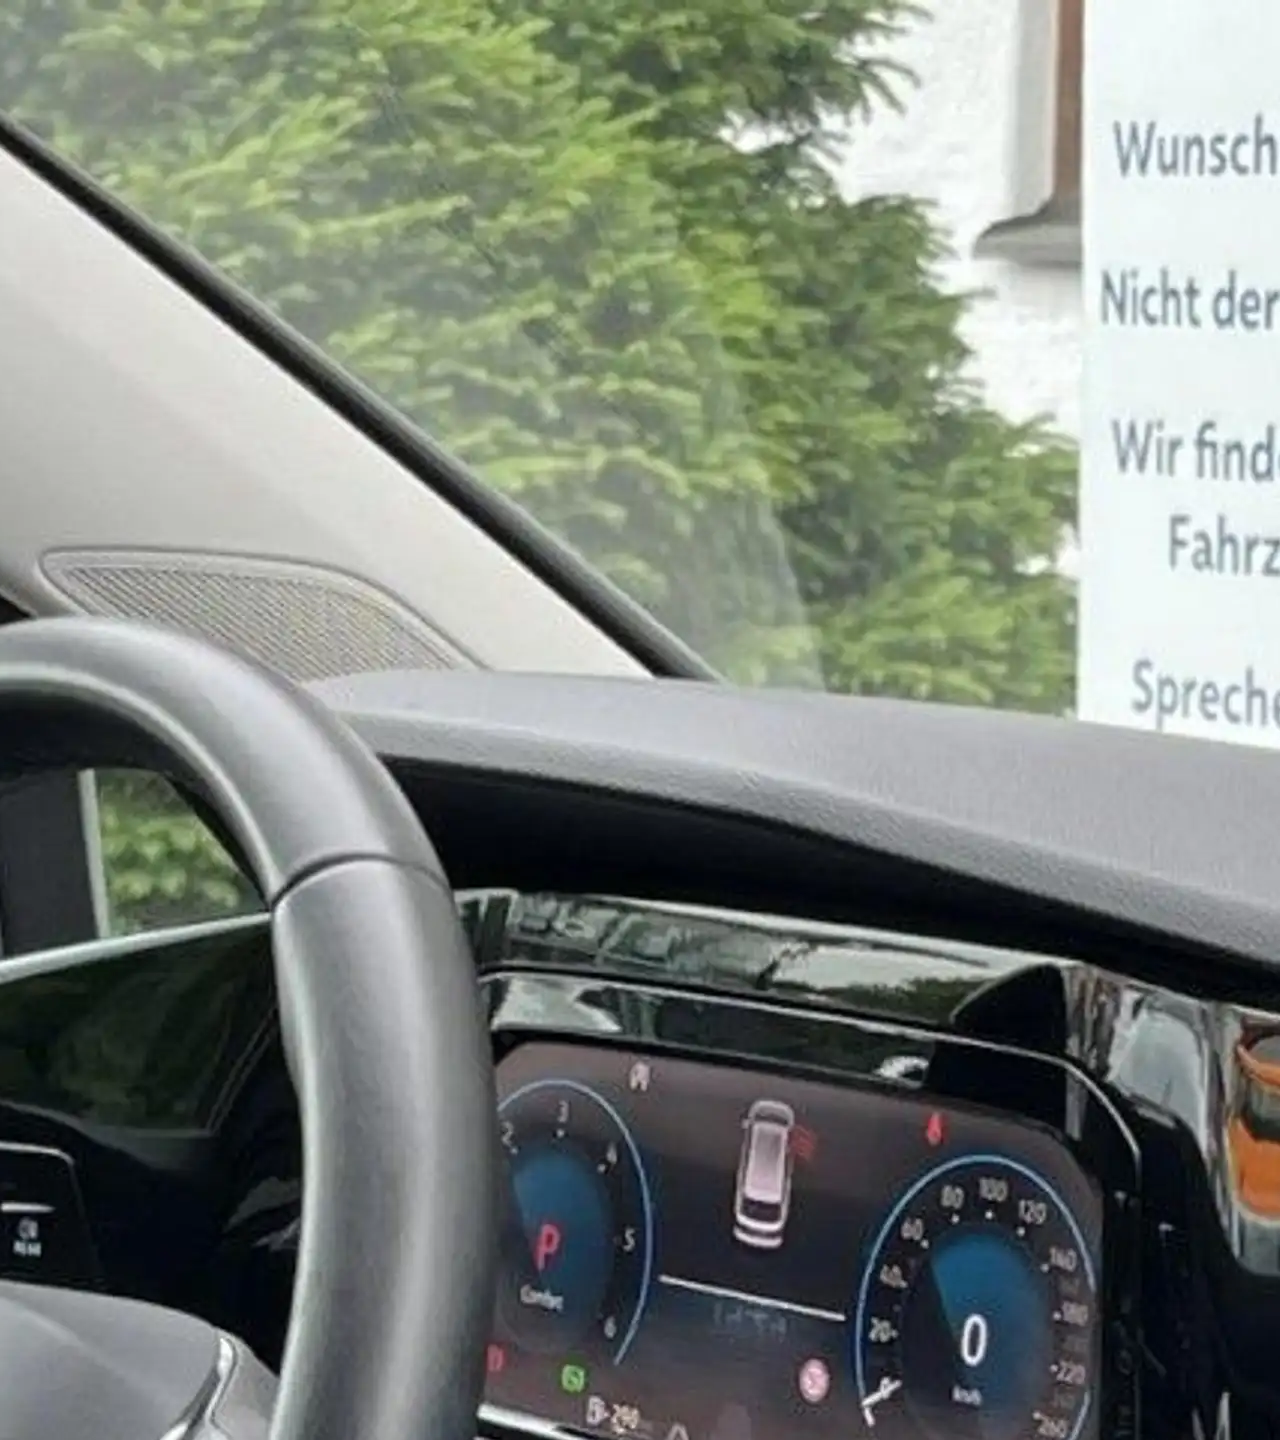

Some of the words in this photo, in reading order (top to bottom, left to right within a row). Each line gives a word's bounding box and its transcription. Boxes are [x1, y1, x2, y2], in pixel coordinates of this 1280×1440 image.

[1100, 268, 1200, 329] Nicht
[1112, 419, 1184, 475] Wir
[940, 1185, 965, 1209] 80
[979, 1177, 1009, 1202] 100
[1019, 1200, 1048, 1225] 120
[536, 1223, 561, 1269] P
[961, 1313, 988, 1367] 0
